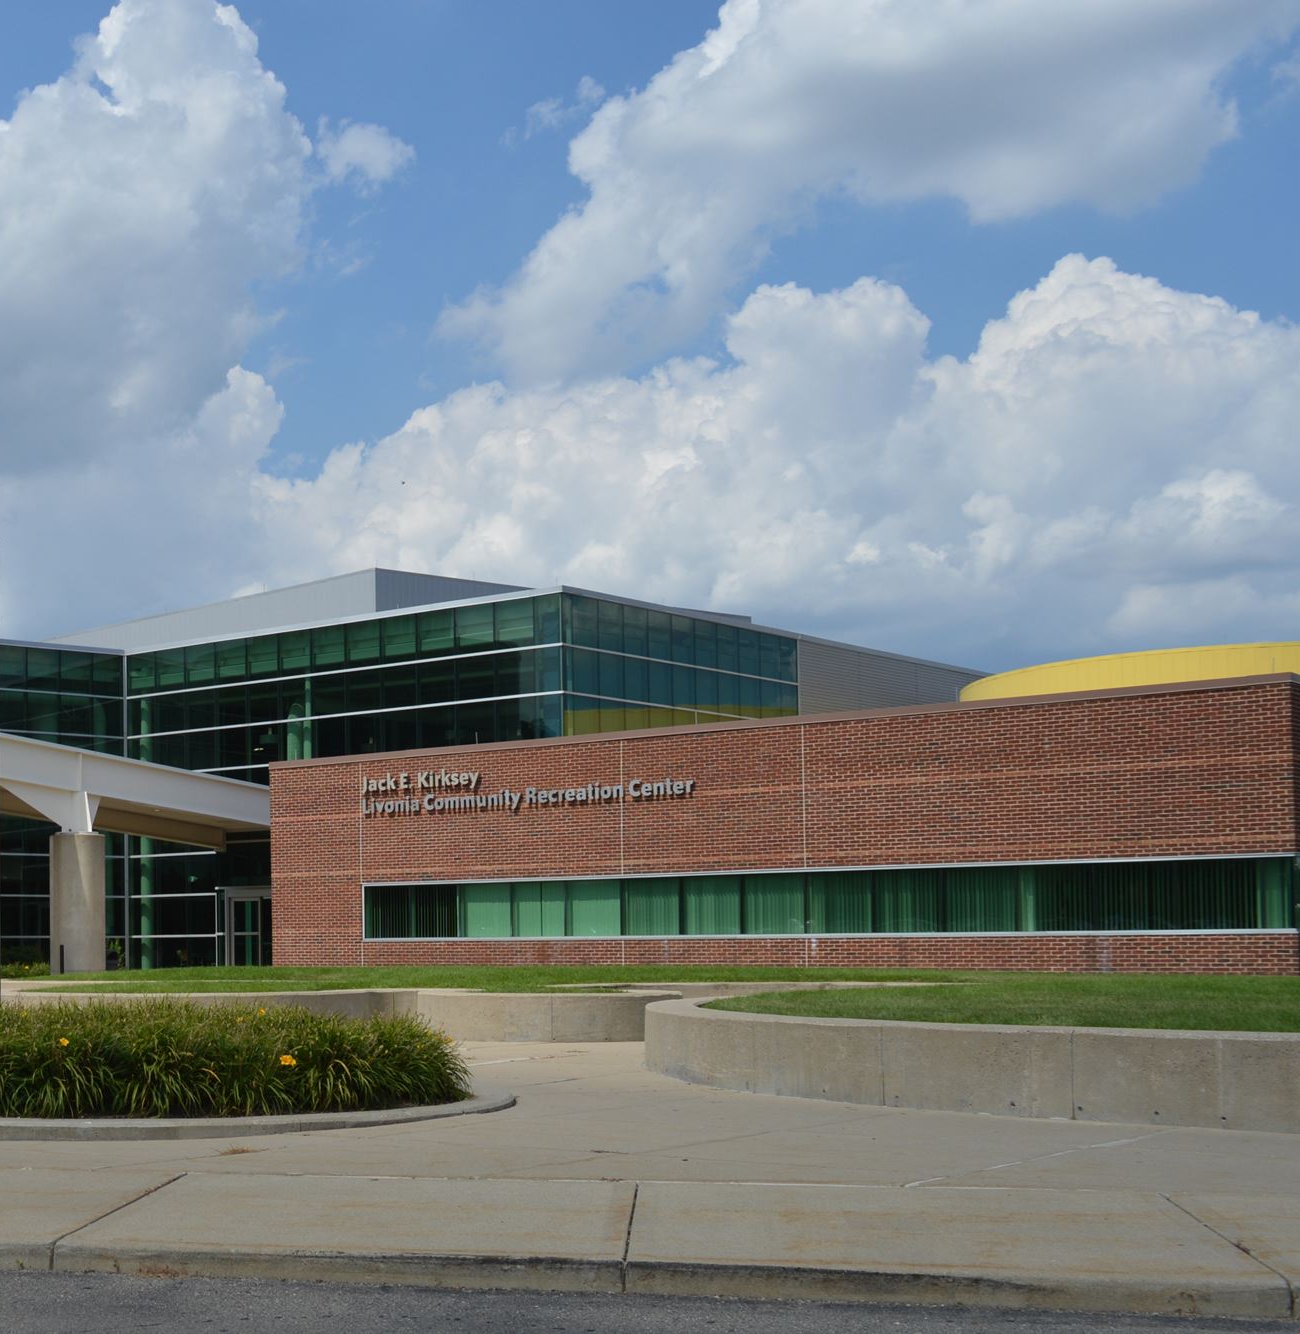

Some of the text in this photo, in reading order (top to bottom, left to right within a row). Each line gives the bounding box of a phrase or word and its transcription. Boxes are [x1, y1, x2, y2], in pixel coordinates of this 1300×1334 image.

[363, 769, 479, 793] Jack E. Kirksey
[363, 777, 695, 814] Livonia Community Recreation Center
